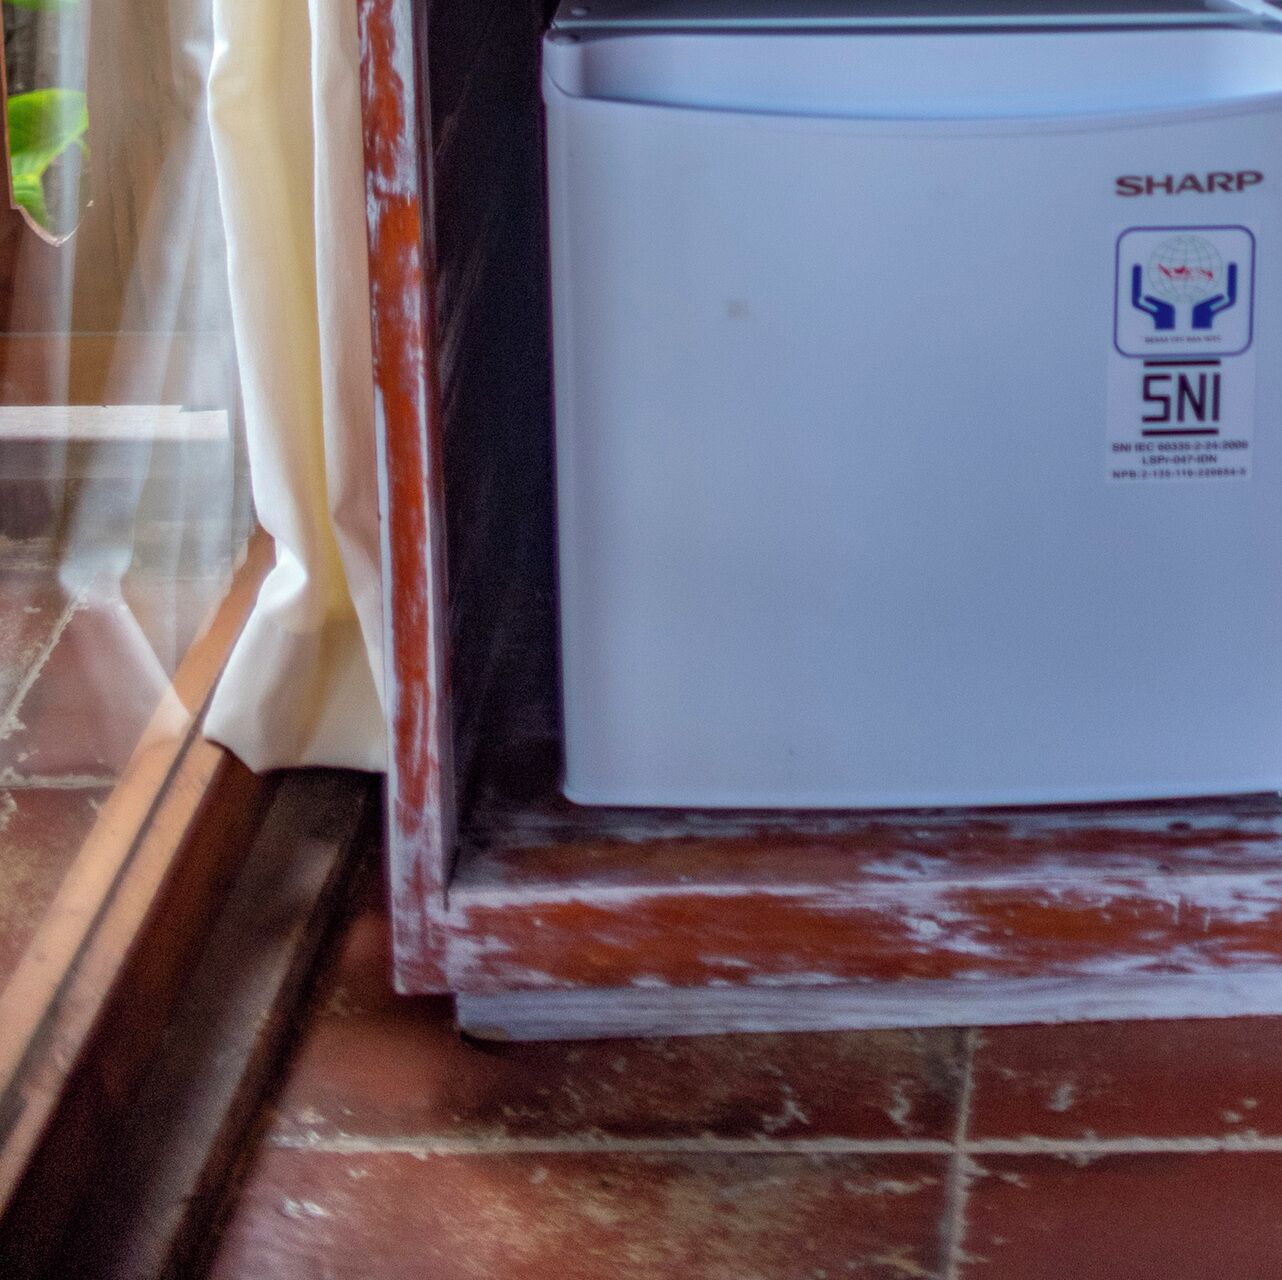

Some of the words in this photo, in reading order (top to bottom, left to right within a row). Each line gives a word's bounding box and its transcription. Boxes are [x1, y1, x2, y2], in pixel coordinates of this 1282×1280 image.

[1115, 170, 1264, 198] SHARP
[1142, 371, 1221, 423] SNI
[1112, 441, 1132, 452] SNI
[1135, 441, 1154, 452] IEC
